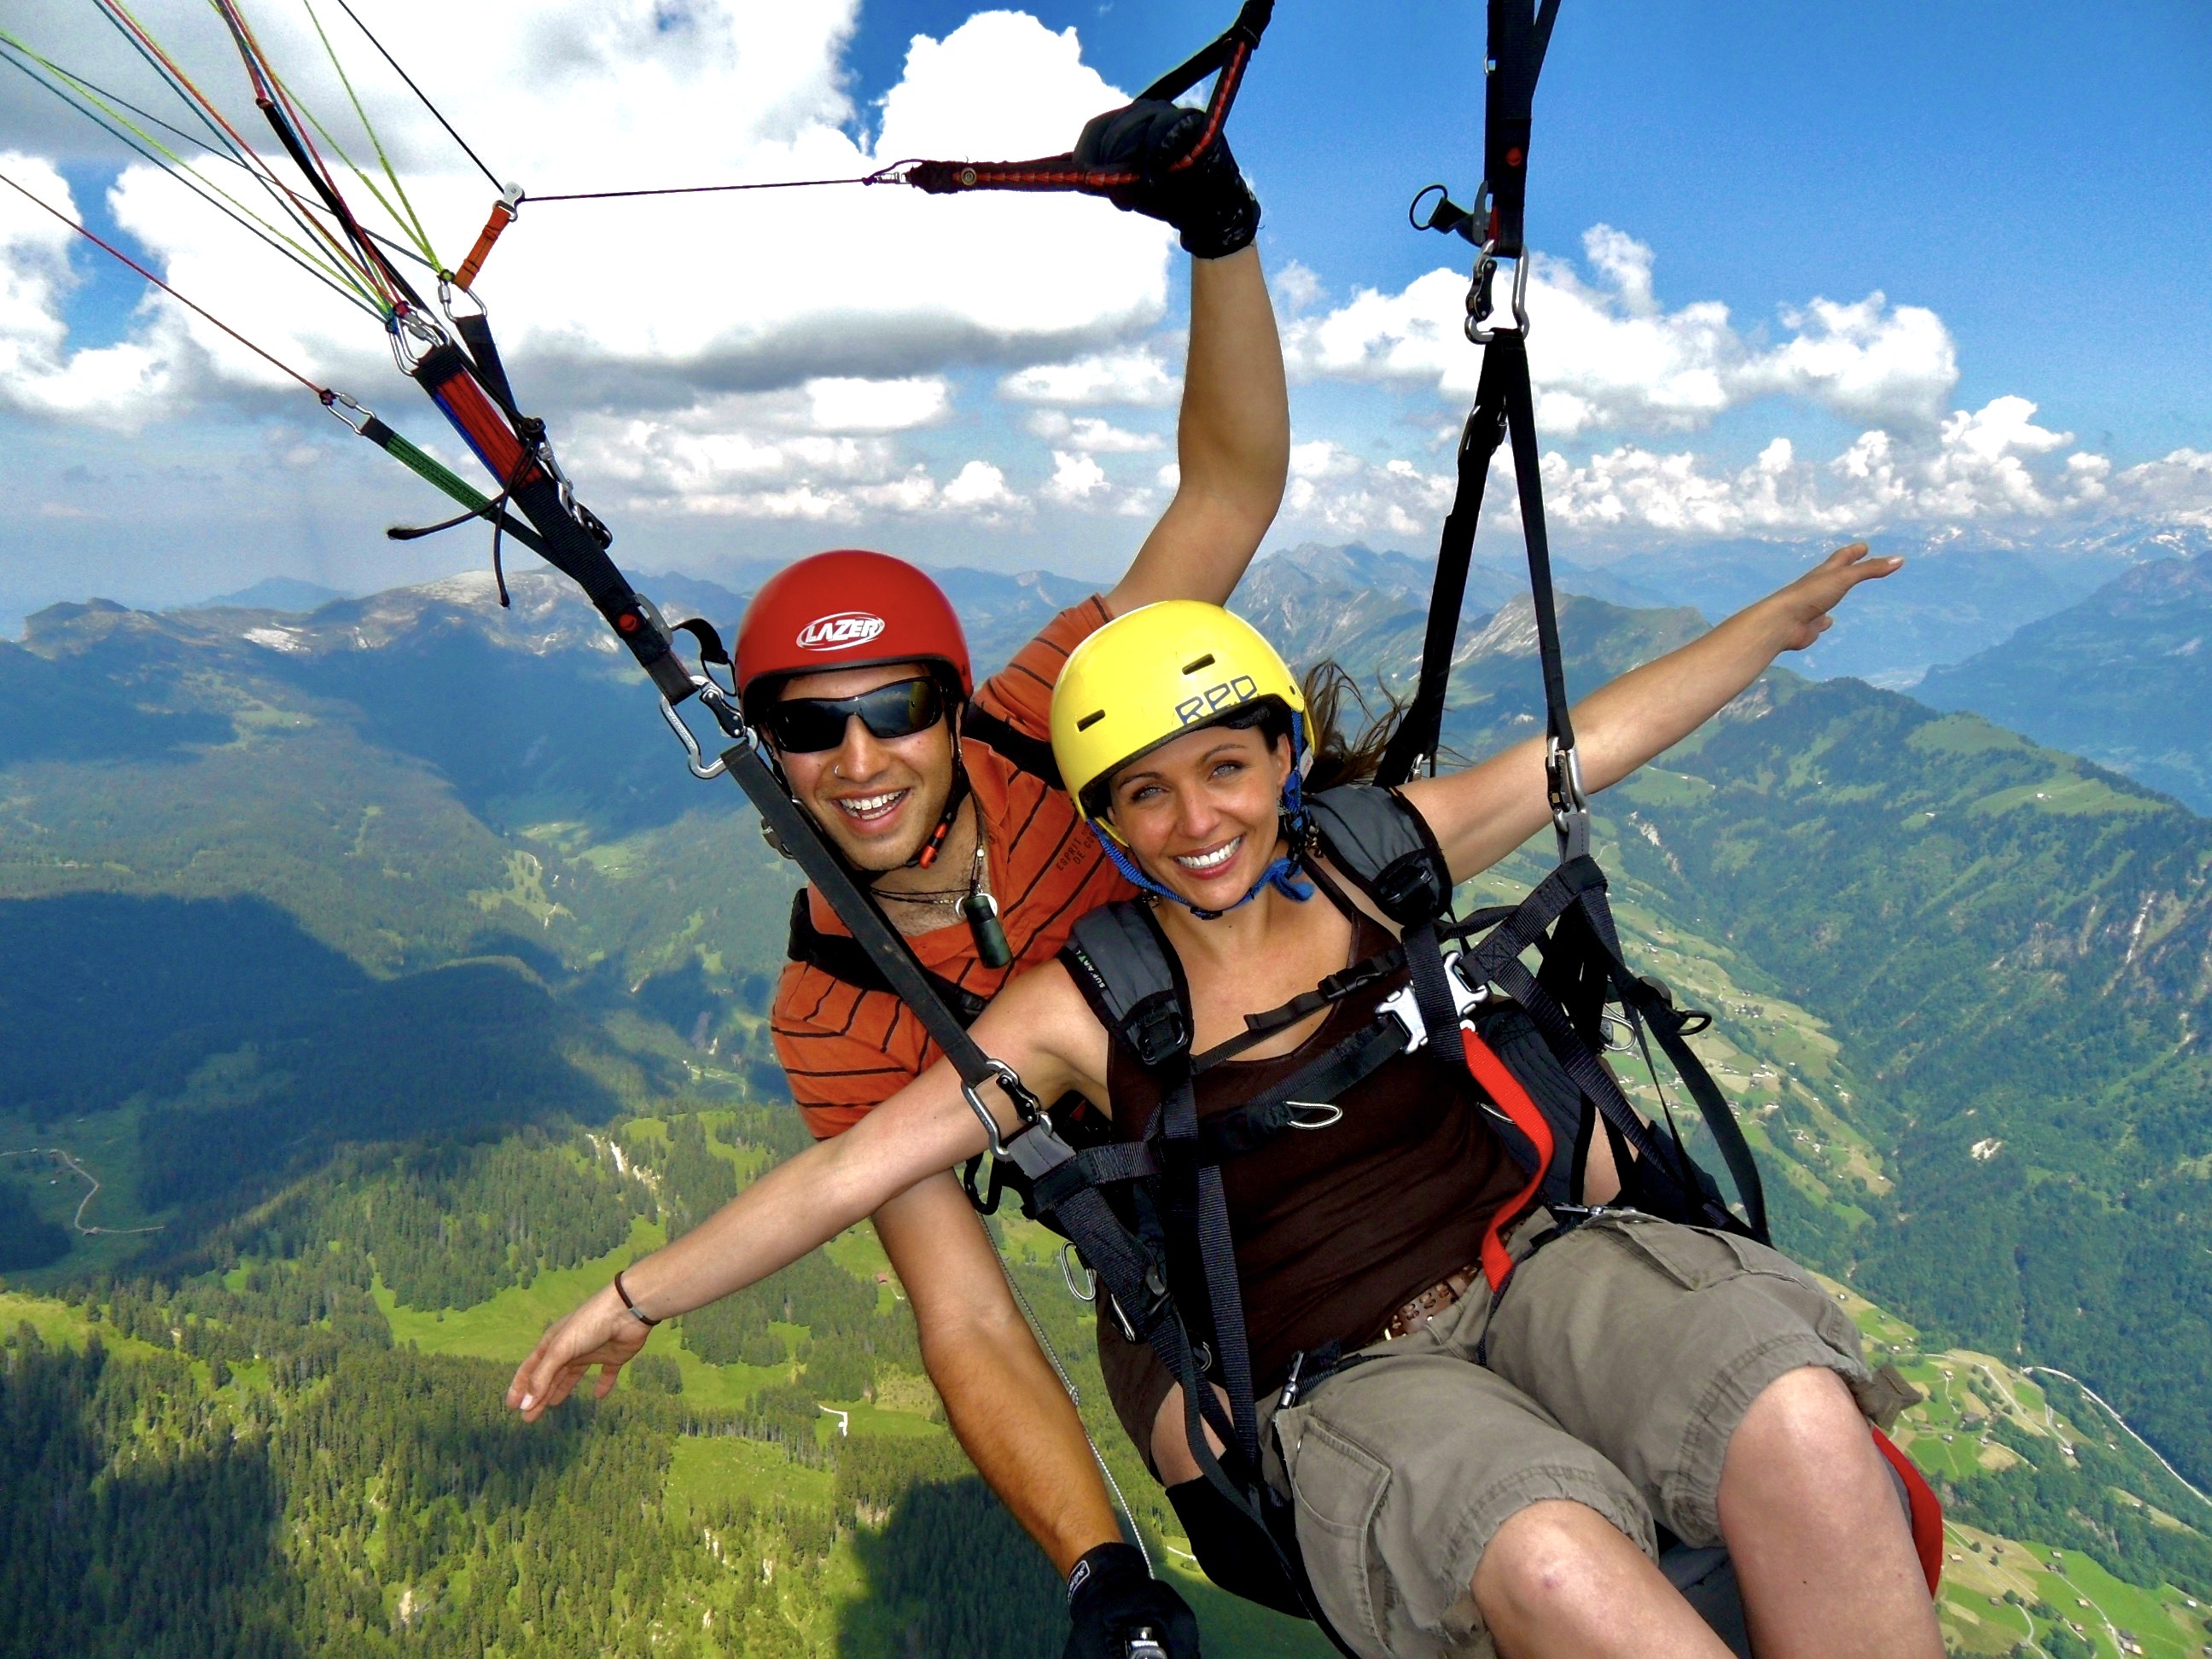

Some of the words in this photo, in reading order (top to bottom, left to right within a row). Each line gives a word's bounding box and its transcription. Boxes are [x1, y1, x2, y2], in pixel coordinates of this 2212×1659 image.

[805, 618, 880, 643] LAZER
[1174, 674, 1258, 725] RPD
[1056, 836, 1082, 871] ESPRIT
[1073, 851, 1086, 864] DE
